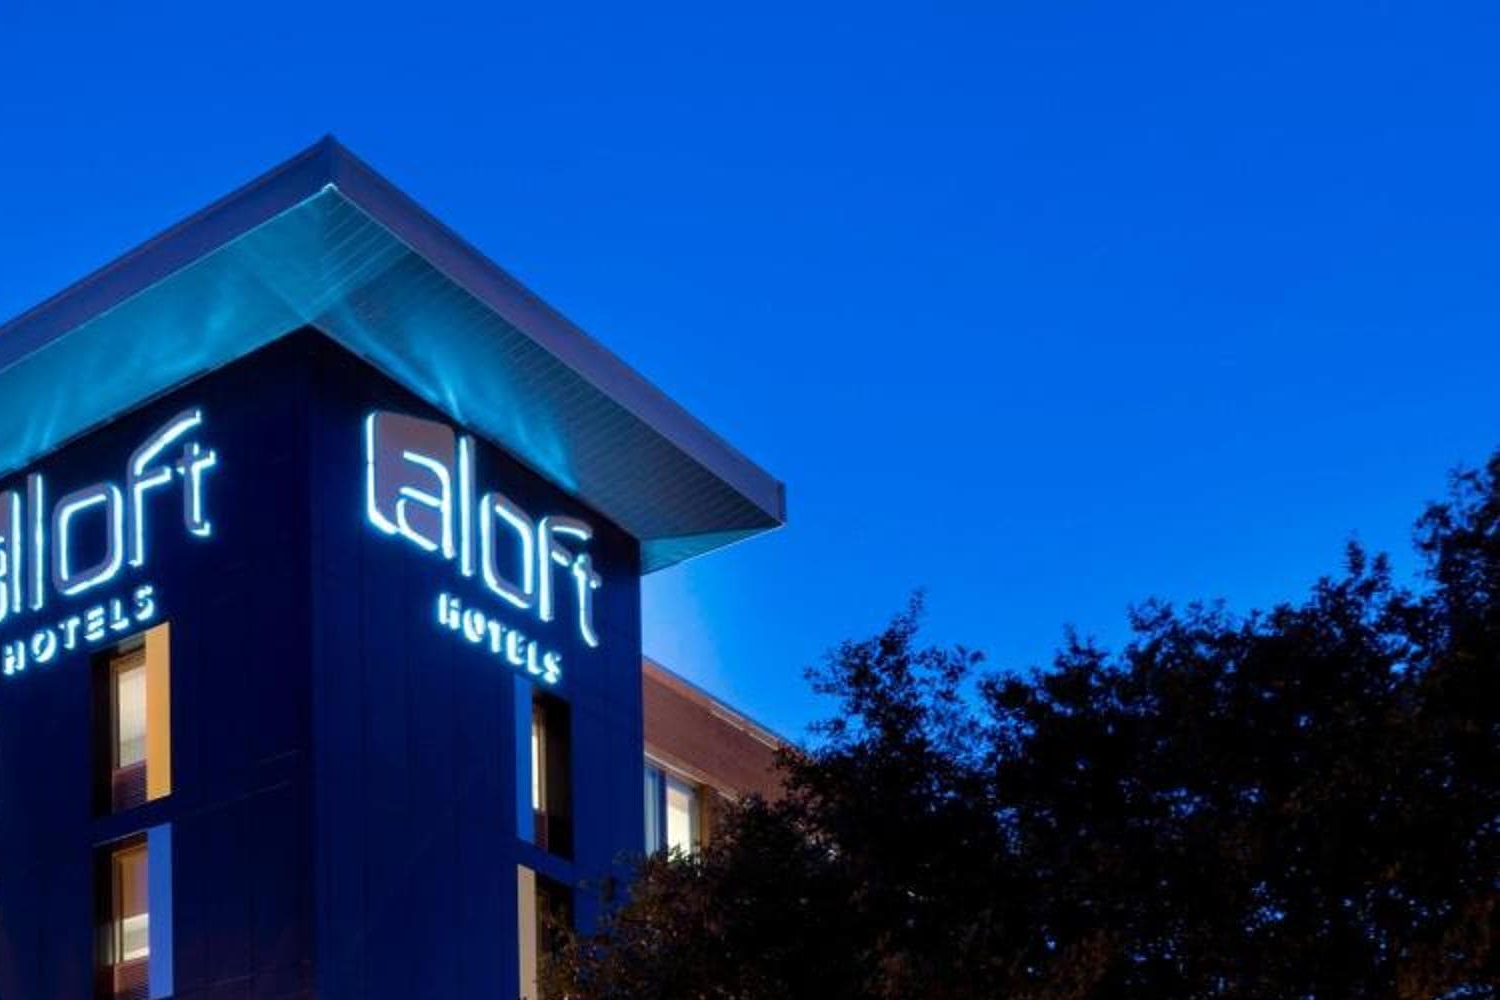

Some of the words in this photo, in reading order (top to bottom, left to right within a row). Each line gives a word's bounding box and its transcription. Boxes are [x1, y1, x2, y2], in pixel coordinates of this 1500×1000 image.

[365, 409, 601, 648] aloft
[2, 584, 156, 676] HOTELS
[438, 592, 563, 685] HOTELS
